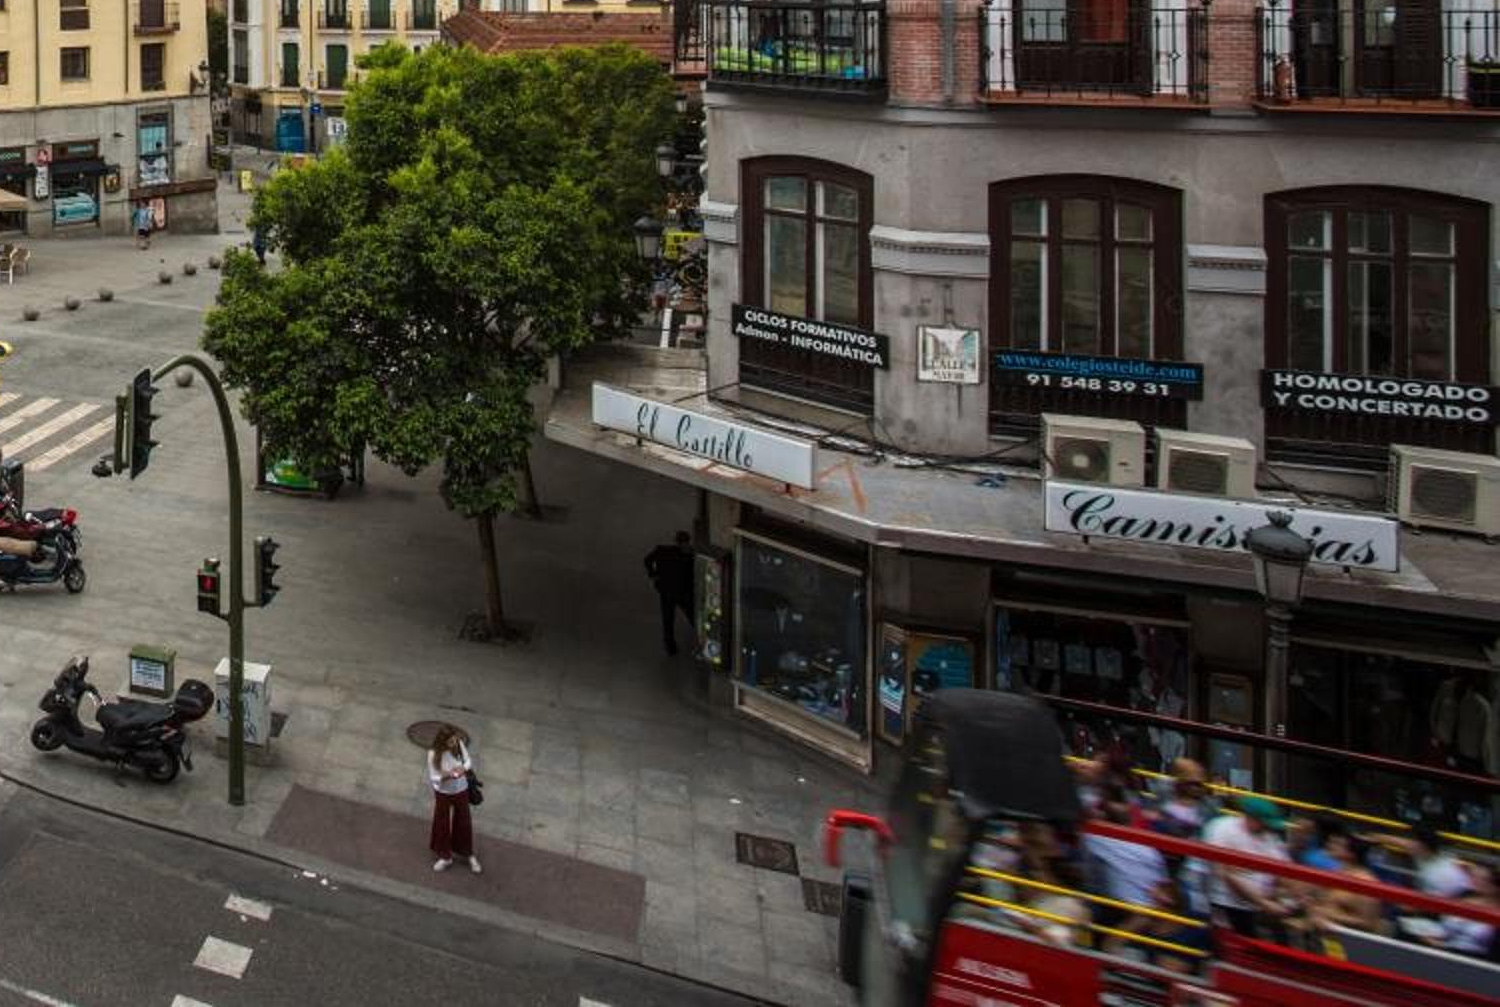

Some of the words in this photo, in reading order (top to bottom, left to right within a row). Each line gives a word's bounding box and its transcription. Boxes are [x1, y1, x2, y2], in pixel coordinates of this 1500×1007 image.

[744, 310, 787, 329] CICLOS
[790, 320, 877, 348] FORMATIVOS
[997, 353, 1197, 379] www.colegiosteide.com
[1026, 373, 1050, 386] 91
[1060, 376, 1102, 391] 548
[1108, 379, 1137, 393] 39
[1142, 382, 1170, 396] 31
[1273, 372, 1490, 403] HOMOLOGADO
[636, 402, 660, 440] El
[1273, 391, 1292, 407] Y
[1297, 394, 1490, 423] CONCERTADO
[1062, 489, 1379, 566] Camisias
